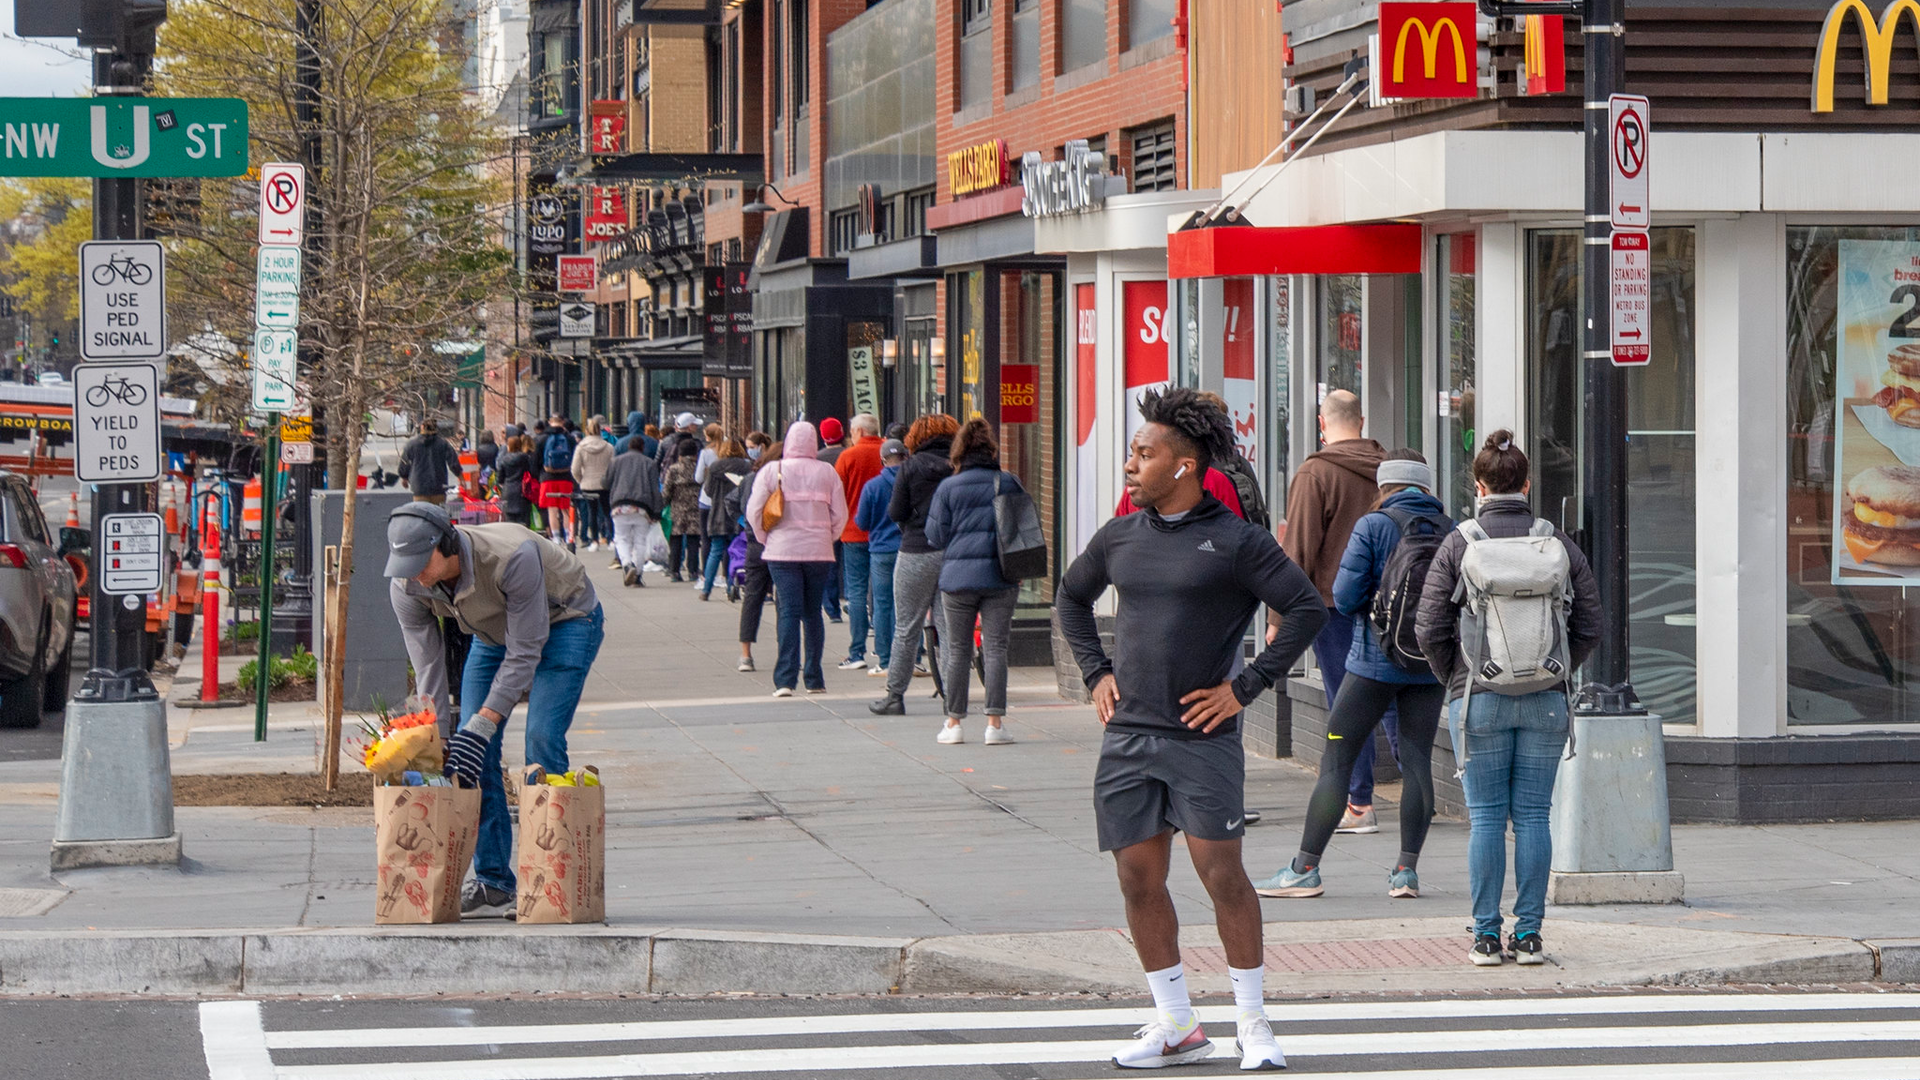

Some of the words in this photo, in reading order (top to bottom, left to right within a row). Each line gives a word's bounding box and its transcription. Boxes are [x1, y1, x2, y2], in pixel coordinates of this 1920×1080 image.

[6, 123, 60, 158] NW
[90, 105, 150, 169] U
[186, 123, 227, 159] ST
[948, 146, 974, 195] WELLS
[974, 138, 1000, 190] FARGO
[587, 222, 627, 237] JOE'S
[1628, 237, 1641, 247] WAY
[264, 257, 270, 268] 2
[273, 257, 295, 269] HOUR
[1625, 253, 1635, 265] NO
[1911, 256, 1920, 267] li
[562, 263, 594, 271] TRADER
[261, 272, 296, 283] PARKING
[1614, 268, 1646, 281] STANDING
[1614, 284, 1622, 296] OR
[1624, 284, 1647, 296] PARKING
[106, 292, 139, 308] USE
[1616, 301, 1632, 311] METRO
[1634, 301, 1645, 311] BUS
[107, 312, 139, 327] PED
[1624, 313, 1638, 323] ZONE
[94, 332, 154, 348] SIGNAL
[268, 358, 283, 368] PAY
[264, 381, 284, 392] PARK
[0, 417, 72, 431] ROWBOA
[91, 415, 139, 431] YIELD
[108, 436, 128, 450] TO
[99, 455, 140, 471] PEDS
[575, 829, 583, 861] JOE'S
[442, 865, 451, 908] TRADER
[447, 829, 455, 862] JOE'S
